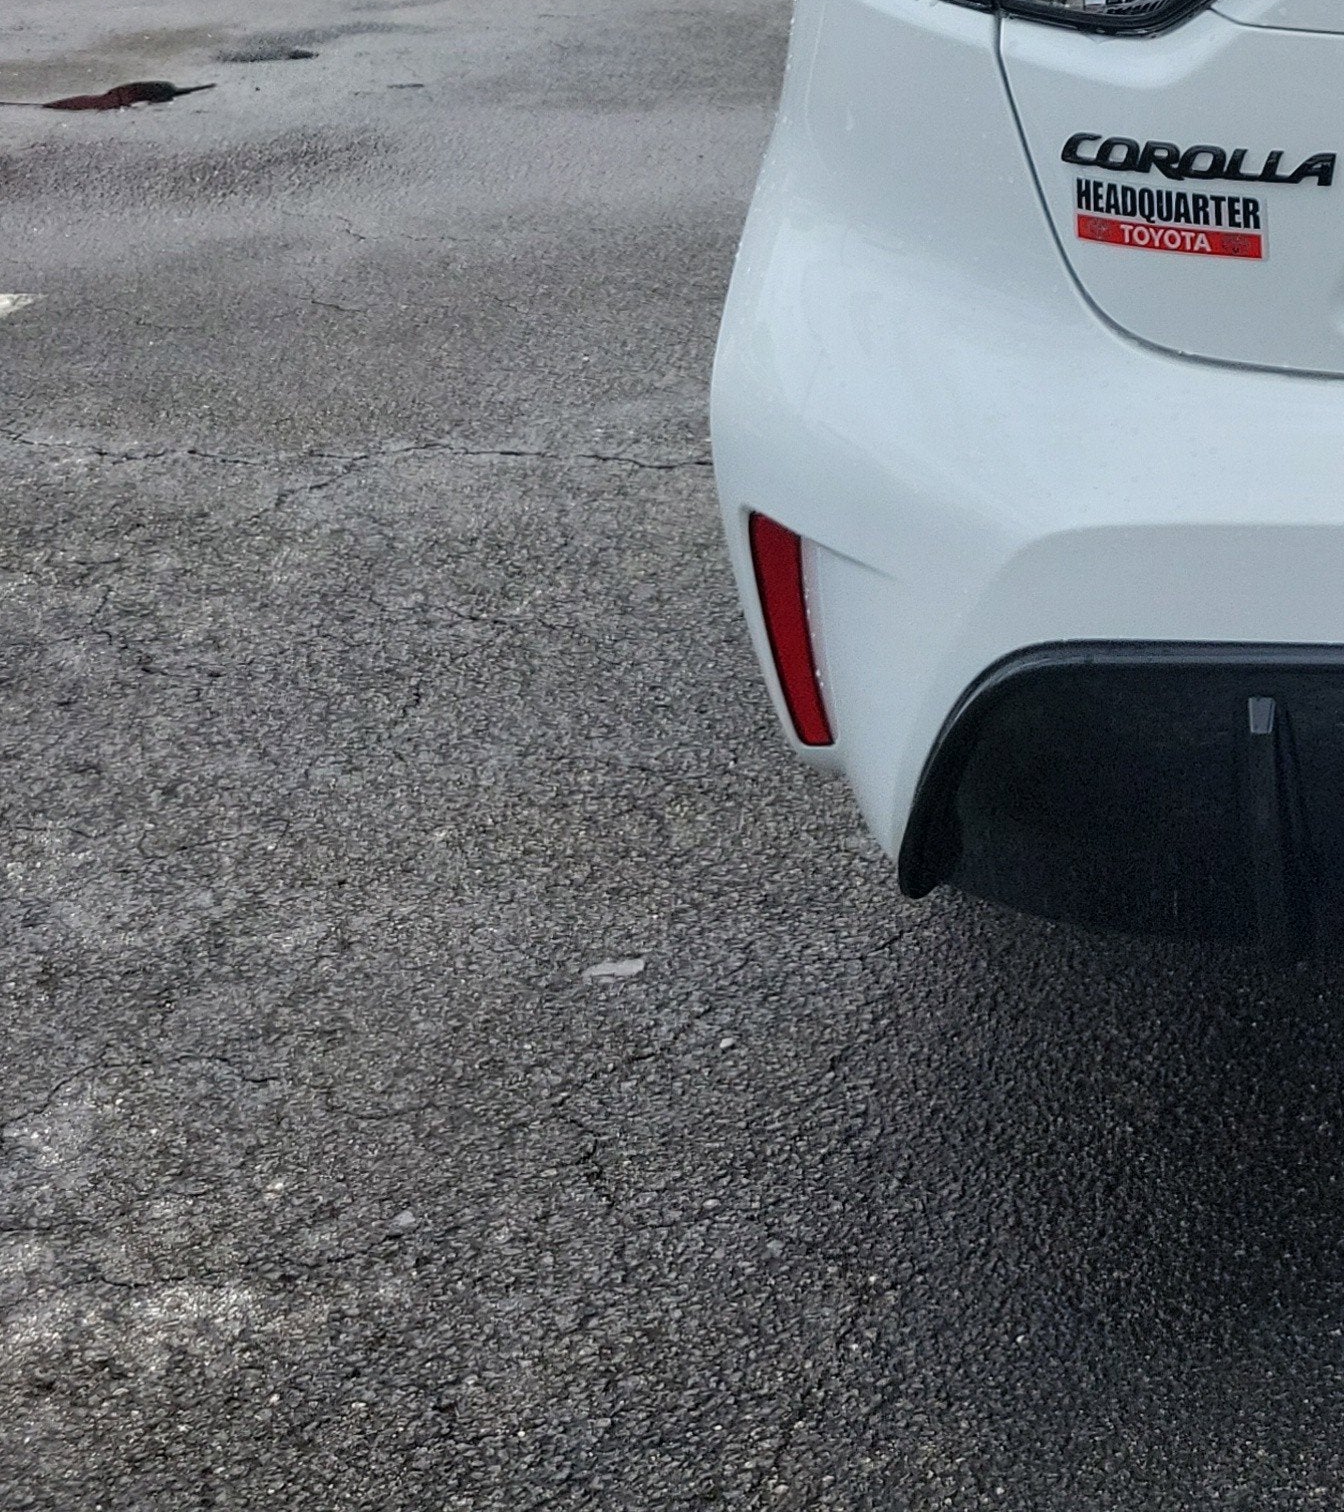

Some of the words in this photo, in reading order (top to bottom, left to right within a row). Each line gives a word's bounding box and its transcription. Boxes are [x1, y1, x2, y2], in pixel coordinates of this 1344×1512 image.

[1060, 131, 1338, 187] COROLLA
[1075, 176, 1262, 230] HEADQUARTER
[1119, 223, 1212, 253] TOYOTA
